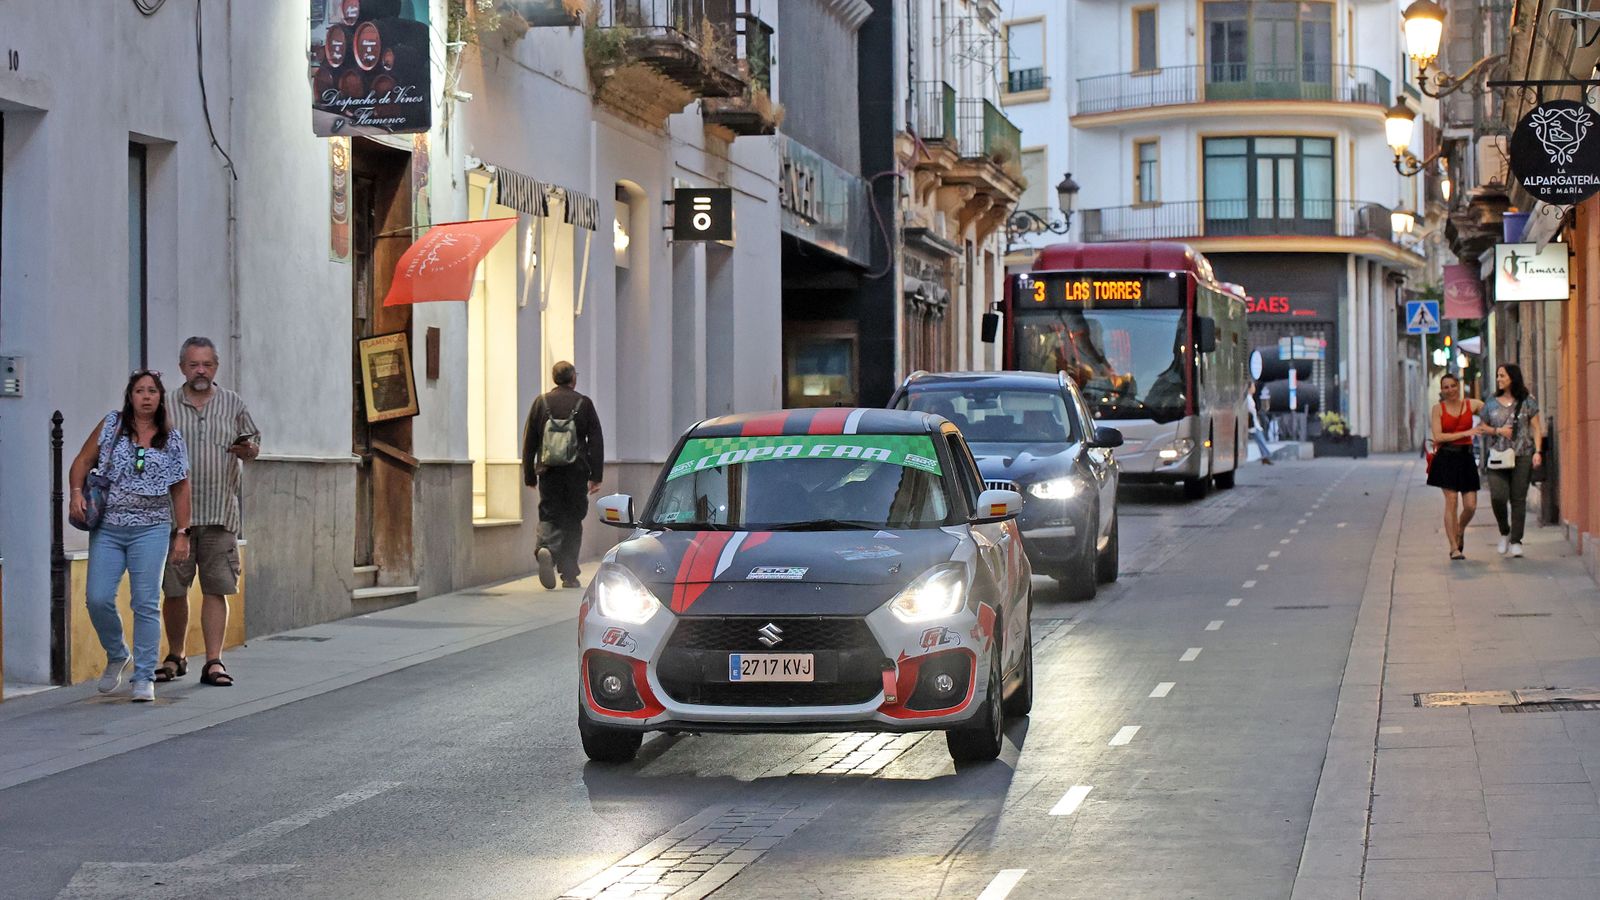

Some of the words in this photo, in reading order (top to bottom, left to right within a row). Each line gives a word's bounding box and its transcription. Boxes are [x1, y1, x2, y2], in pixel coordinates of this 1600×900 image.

[9, 49, 19, 71] 10
[321, 88, 377, 112] Despacho
[378, 90, 391, 104] de
[392, 85, 424, 104] Vinos
[350, 106, 406, 126] Flamenco
[1523, 174, 1600, 186] ALPARGATERÍA
[1555, 186, 1583, 194] MARÍA
[1520, 260, 1566, 274] Tamara
[1033, 281, 1046, 302] 3
[1065, 281, 1090, 300] LAS
[1093, 281, 1141, 300] TORRES
[695, 444, 804, 470] COPA
[808, 444, 892, 461] FAA
[742, 660, 779, 675] 2717
[783, 660, 811, 675] KVJ
